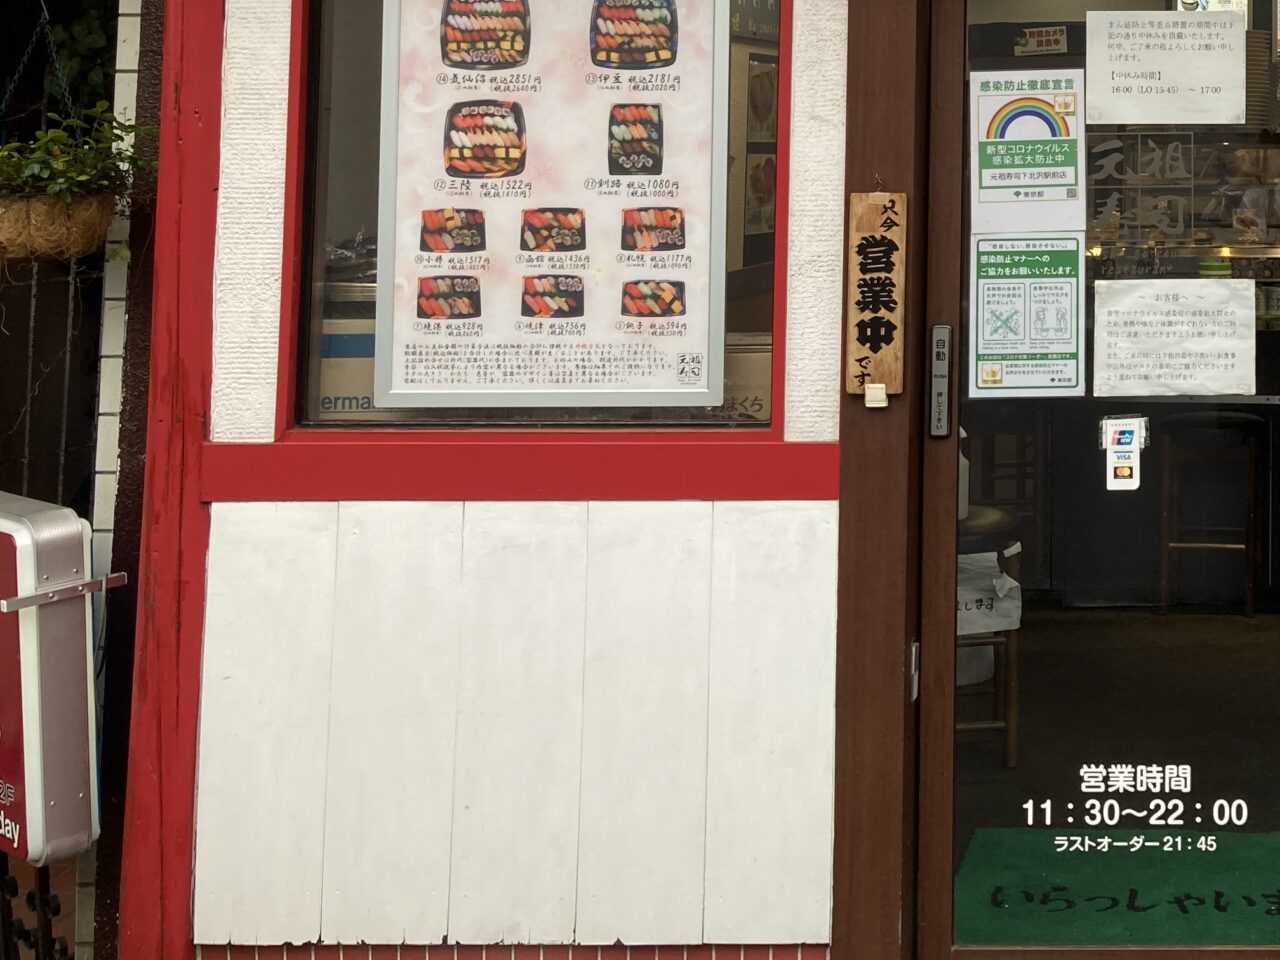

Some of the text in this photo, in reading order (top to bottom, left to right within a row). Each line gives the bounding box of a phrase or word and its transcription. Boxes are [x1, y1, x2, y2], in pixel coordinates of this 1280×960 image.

[1108, 54, 1142, 62] 上げます。
[980, 79, 1075, 92] 感染防止徹底宣言
[986, 143, 1070, 155] 新型コロナウイルス
[992, 154, 1065, 165] 感染拡大防止中
[990, 171, 1067, 181] 元祖寿司下北沢駅前店
[1023, 190, 1045, 198] 東京都
[980, 255, 1050, 264] 感染防止マナーへの
[980, 266, 1075, 276] ご協力をお願いいたします。
[854, 235, 900, 355] 営業中
[1154, 293, 1189, 302] お客様へ
[935, 339, 946, 362] 自動
[854, 356, 873, 387] です
[957, 597, 994, 612] します
[1079, 764, 1191, 793] 営業時間
